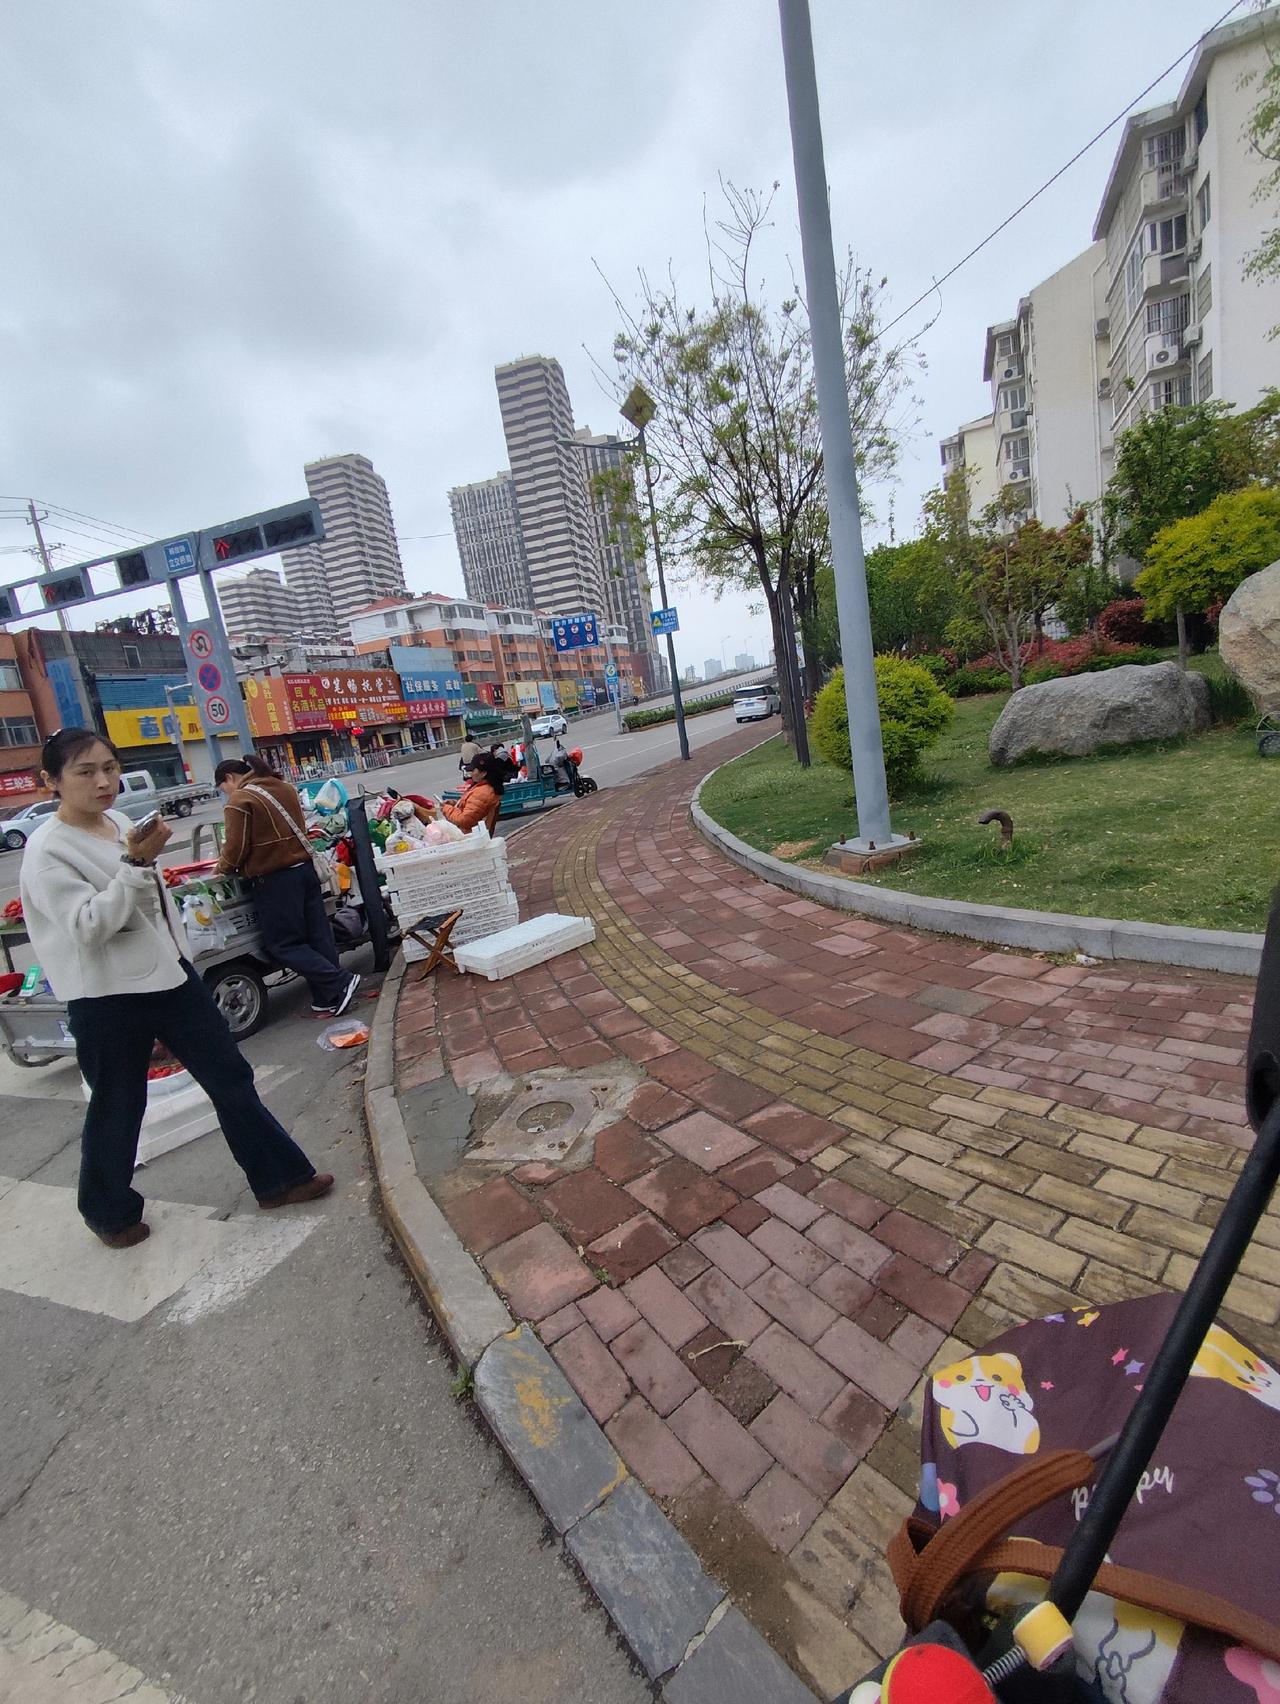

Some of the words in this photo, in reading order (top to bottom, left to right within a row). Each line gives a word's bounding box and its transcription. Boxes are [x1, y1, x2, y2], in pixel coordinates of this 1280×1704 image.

[295, 685, 318, 699] 回收
[211, 704, 226, 718] 50
[292, 697, 326, 713] 名酒礼品
[0, 776, 35, 791] 三轮车
[1070, 1465, 1175, 1522] ppy
